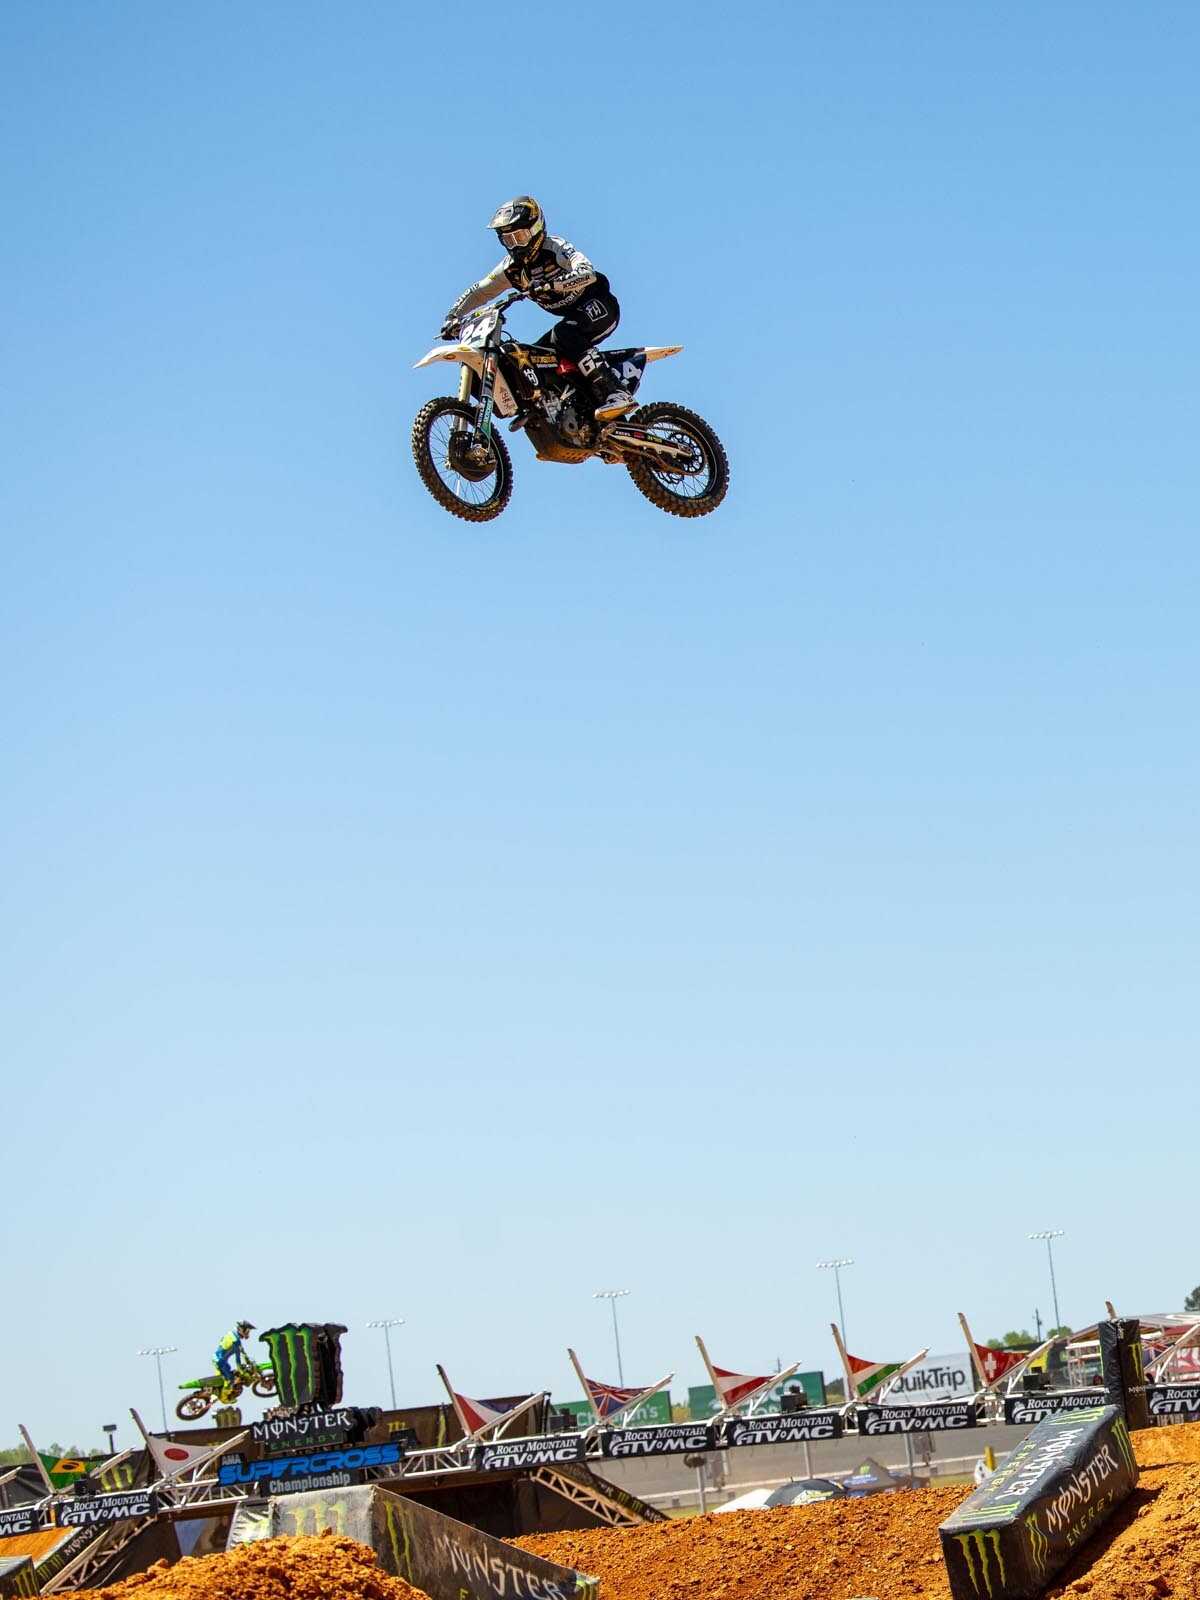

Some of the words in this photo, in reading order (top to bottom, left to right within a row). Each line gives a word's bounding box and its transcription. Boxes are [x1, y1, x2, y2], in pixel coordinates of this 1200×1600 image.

[461, 318, 491, 346] 24
[891, 1367, 966, 1395] QuikTrip
[1027, 1398, 1059, 1409] ROCKY
[1061, 1395, 1106, 1407] MOUNTA
[1167, 1389, 1200, 1400] ROCKY
[749, 1420, 778, 1430] ROCKY
[780, 1416, 833, 1428] MOUNTAIN
[882, 1409, 912, 1419] ROCKY
[914, 1405, 967, 1417] MOUNTAIN
[253, 1411, 350, 1440] MONSTER
[625, 1431, 653, 1441] ROCKY
[656, 1427, 706, 1439] MOUNTAIN
[270, 1432, 338, 1450] ENERGY
[497, 1444, 525, 1455] ROCKY
[526, 1438, 577, 1451] MOUNTAIN
[218, 1442, 401, 1486] SUPERCROSS
[222, 1455, 241, 1466] AMA
[984, 1443, 1036, 1492] ENERGY
[994, 1427, 1083, 1499] MONSTER
[269, 1471, 350, 1494] Championship
[1046, 1444, 1118, 1535] MONSTER
[74, 1501, 99, 1512] ROCKY
[102, 1495, 149, 1508] MOUNTAIN
[0, 1511, 31, 1522] UNTAIN
[1066, 1490, 1114, 1547] ENERGY
[64, 1524, 98, 1556] MONST
[433, 1534, 568, 1600] MONSTER
